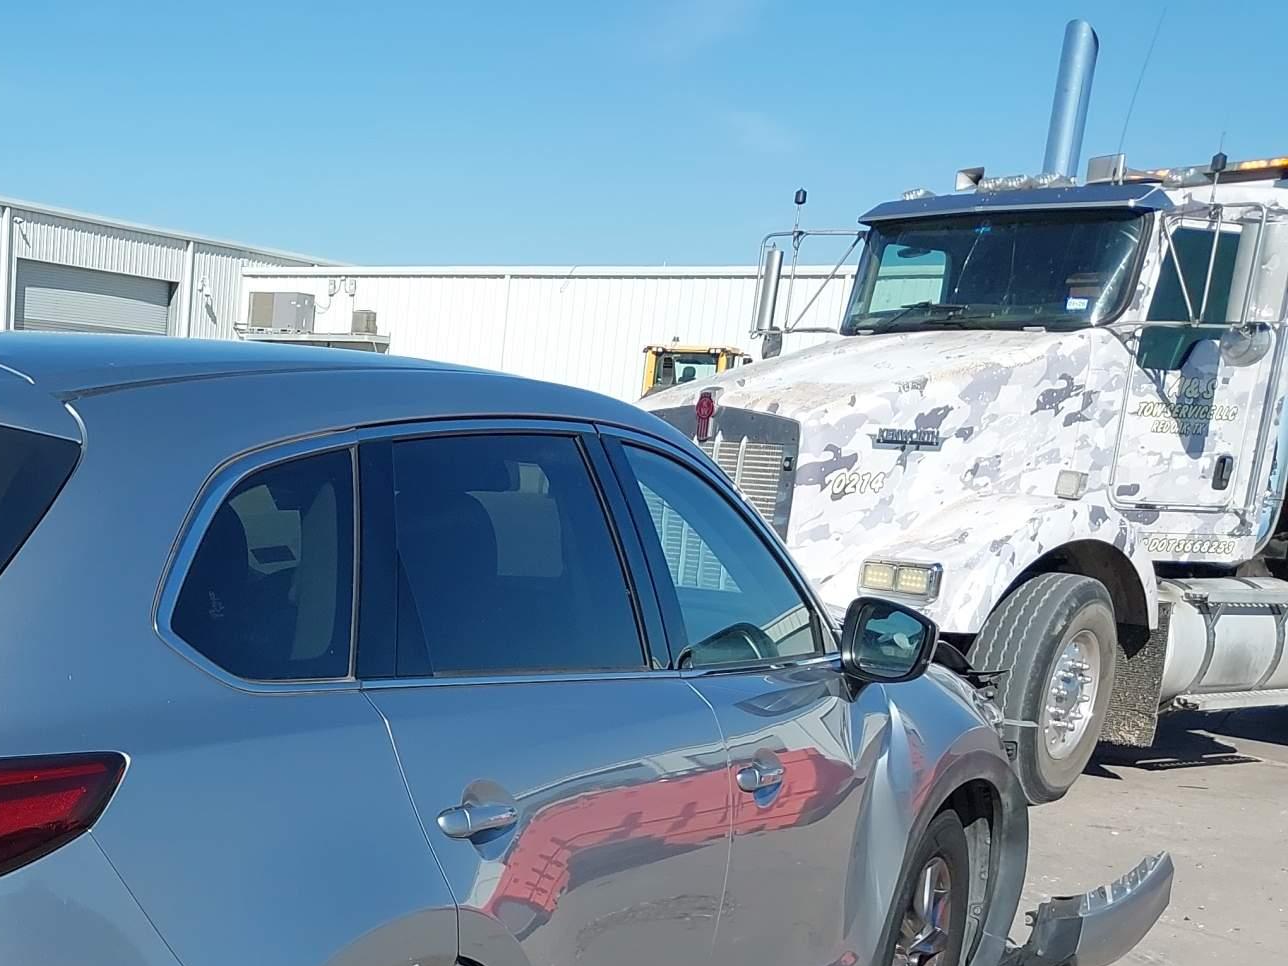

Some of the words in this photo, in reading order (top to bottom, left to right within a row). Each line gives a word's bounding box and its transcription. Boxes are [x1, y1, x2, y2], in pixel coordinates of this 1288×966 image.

[1185, 378, 1201, 399] &
[1202, 378, 1218, 399] S
[1137, 402, 1165, 417] TOW
[1164, 402, 1216, 420] SERVICE
[1215, 406, 1238, 421] LLC
[877, 428, 940, 443] KENWORTH
[1151, 420, 1170, 433] RED
[832, 472, 886, 494] 0214
